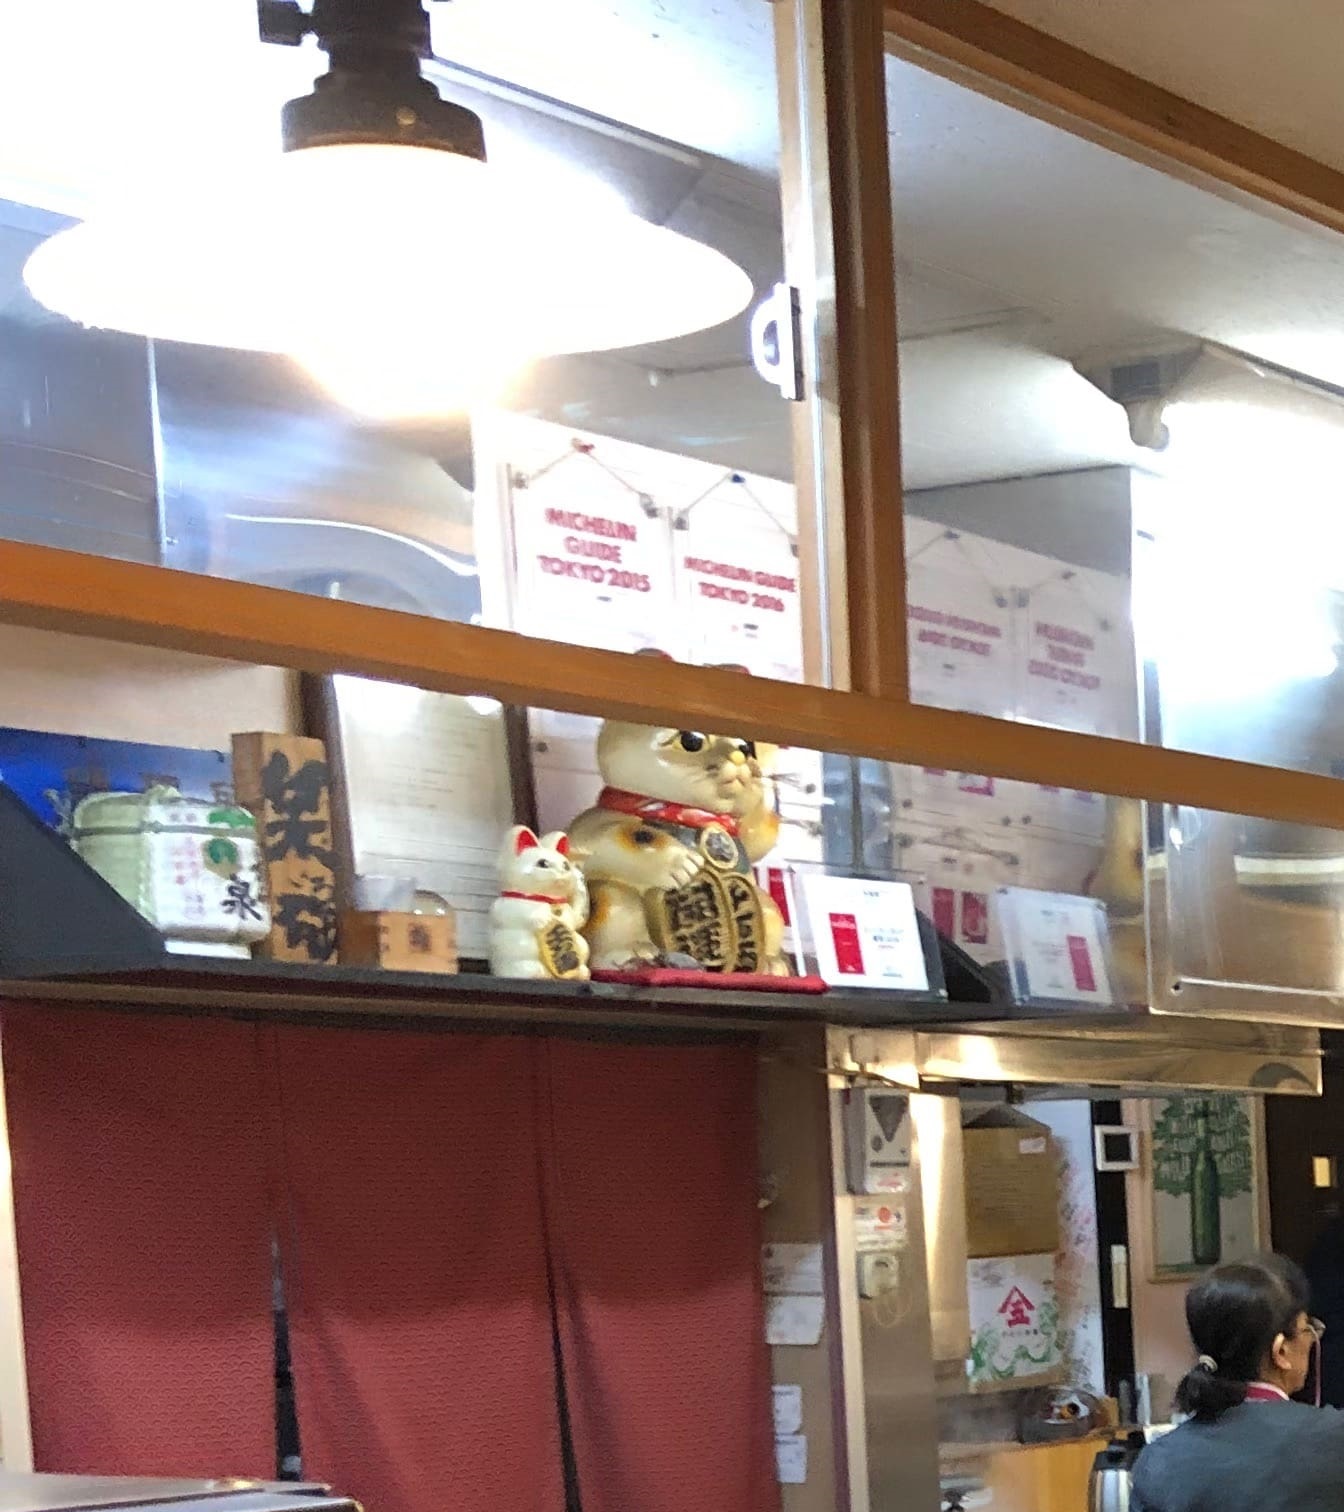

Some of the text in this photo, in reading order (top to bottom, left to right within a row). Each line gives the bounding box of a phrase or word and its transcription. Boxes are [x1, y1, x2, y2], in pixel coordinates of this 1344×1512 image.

[544, 507, 637, 542] MICHELIN
[564, 536, 622, 564] GUIDE
[537, 554, 651, 593] TOKYO 2015
[684, 556, 752, 584] MICHELIN
[699, 581, 749, 606] TOKYO
